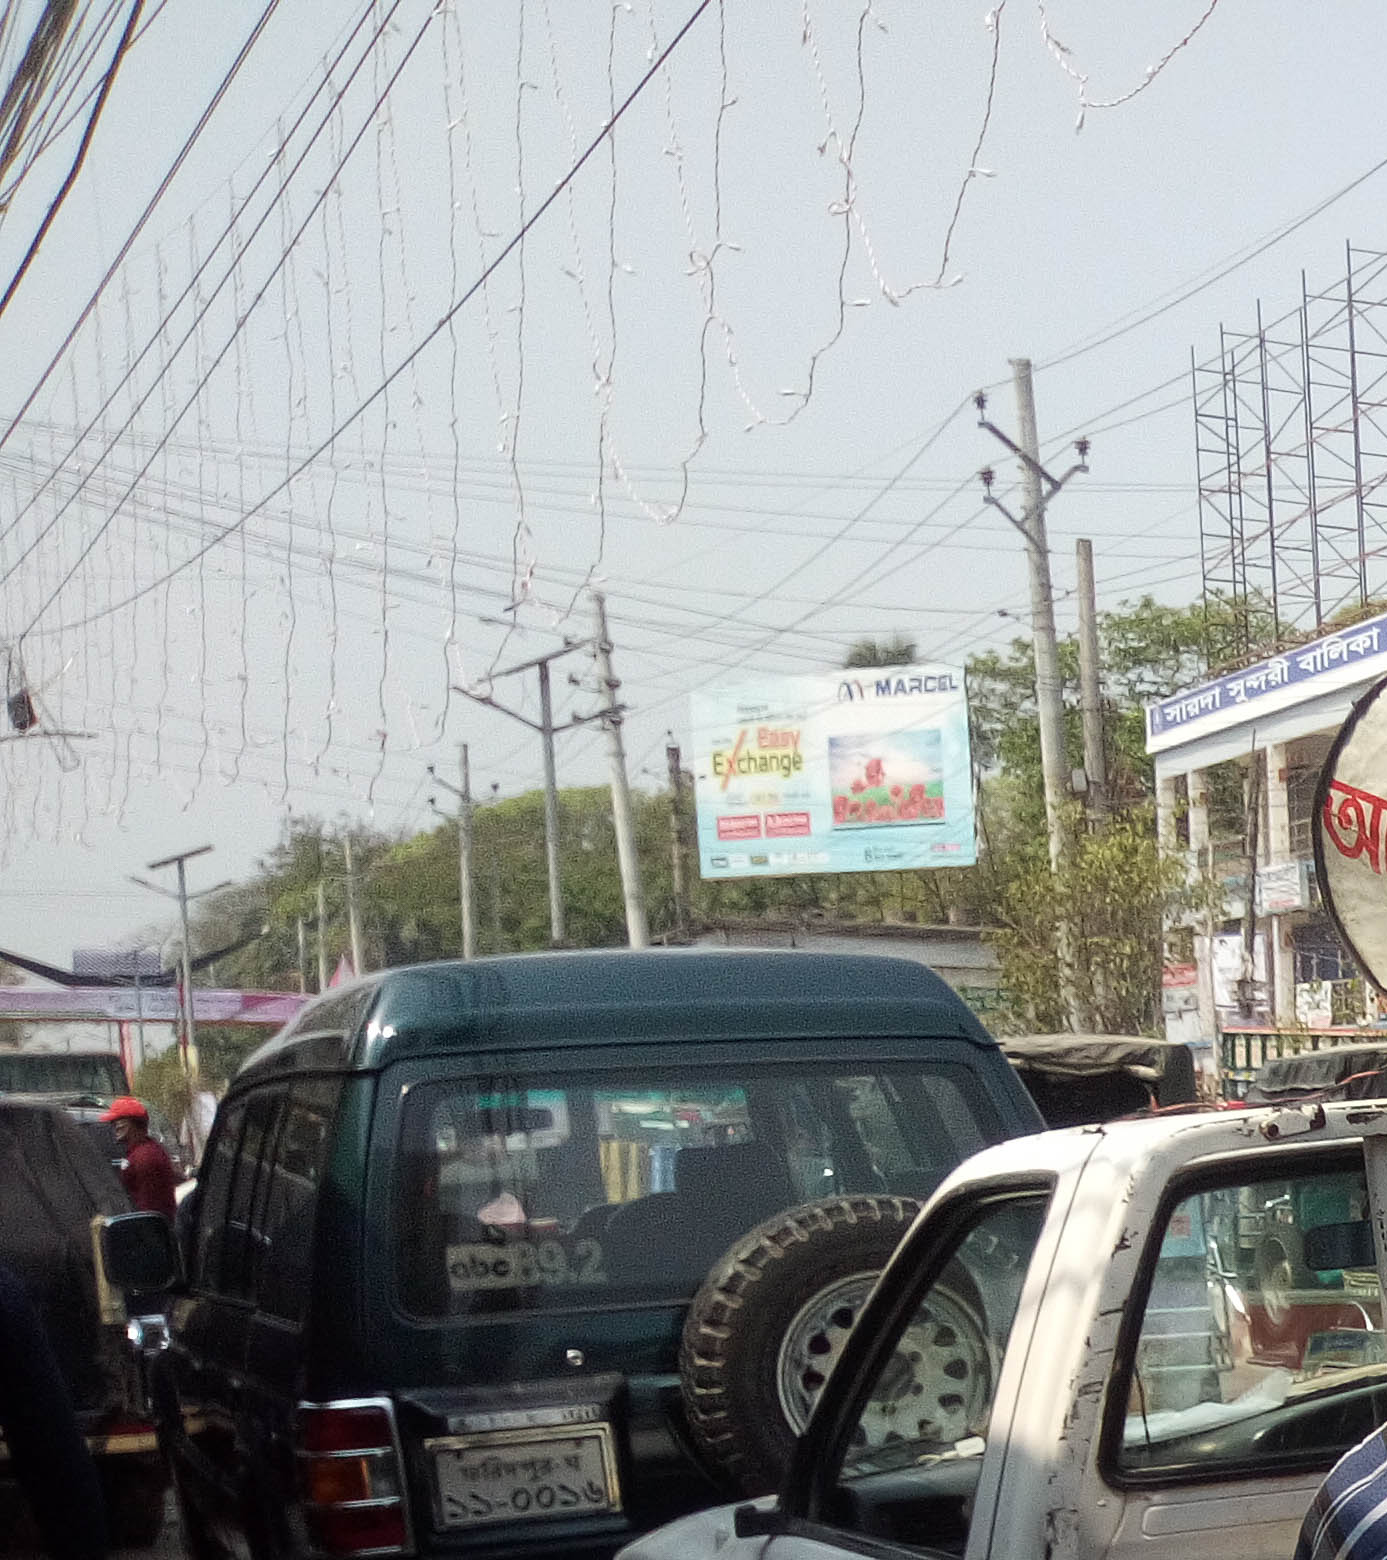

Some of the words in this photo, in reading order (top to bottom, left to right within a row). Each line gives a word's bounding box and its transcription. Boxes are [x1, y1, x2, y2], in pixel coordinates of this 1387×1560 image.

[874, 674, 959, 698] MARCEL
[1164, 687, 1223, 726] সারদা
[1228, 659, 1291, 703] সুন্দরী
[1296, 626, 1380, 675] বালিকা
[449, 1251, 512, 1278] abc
